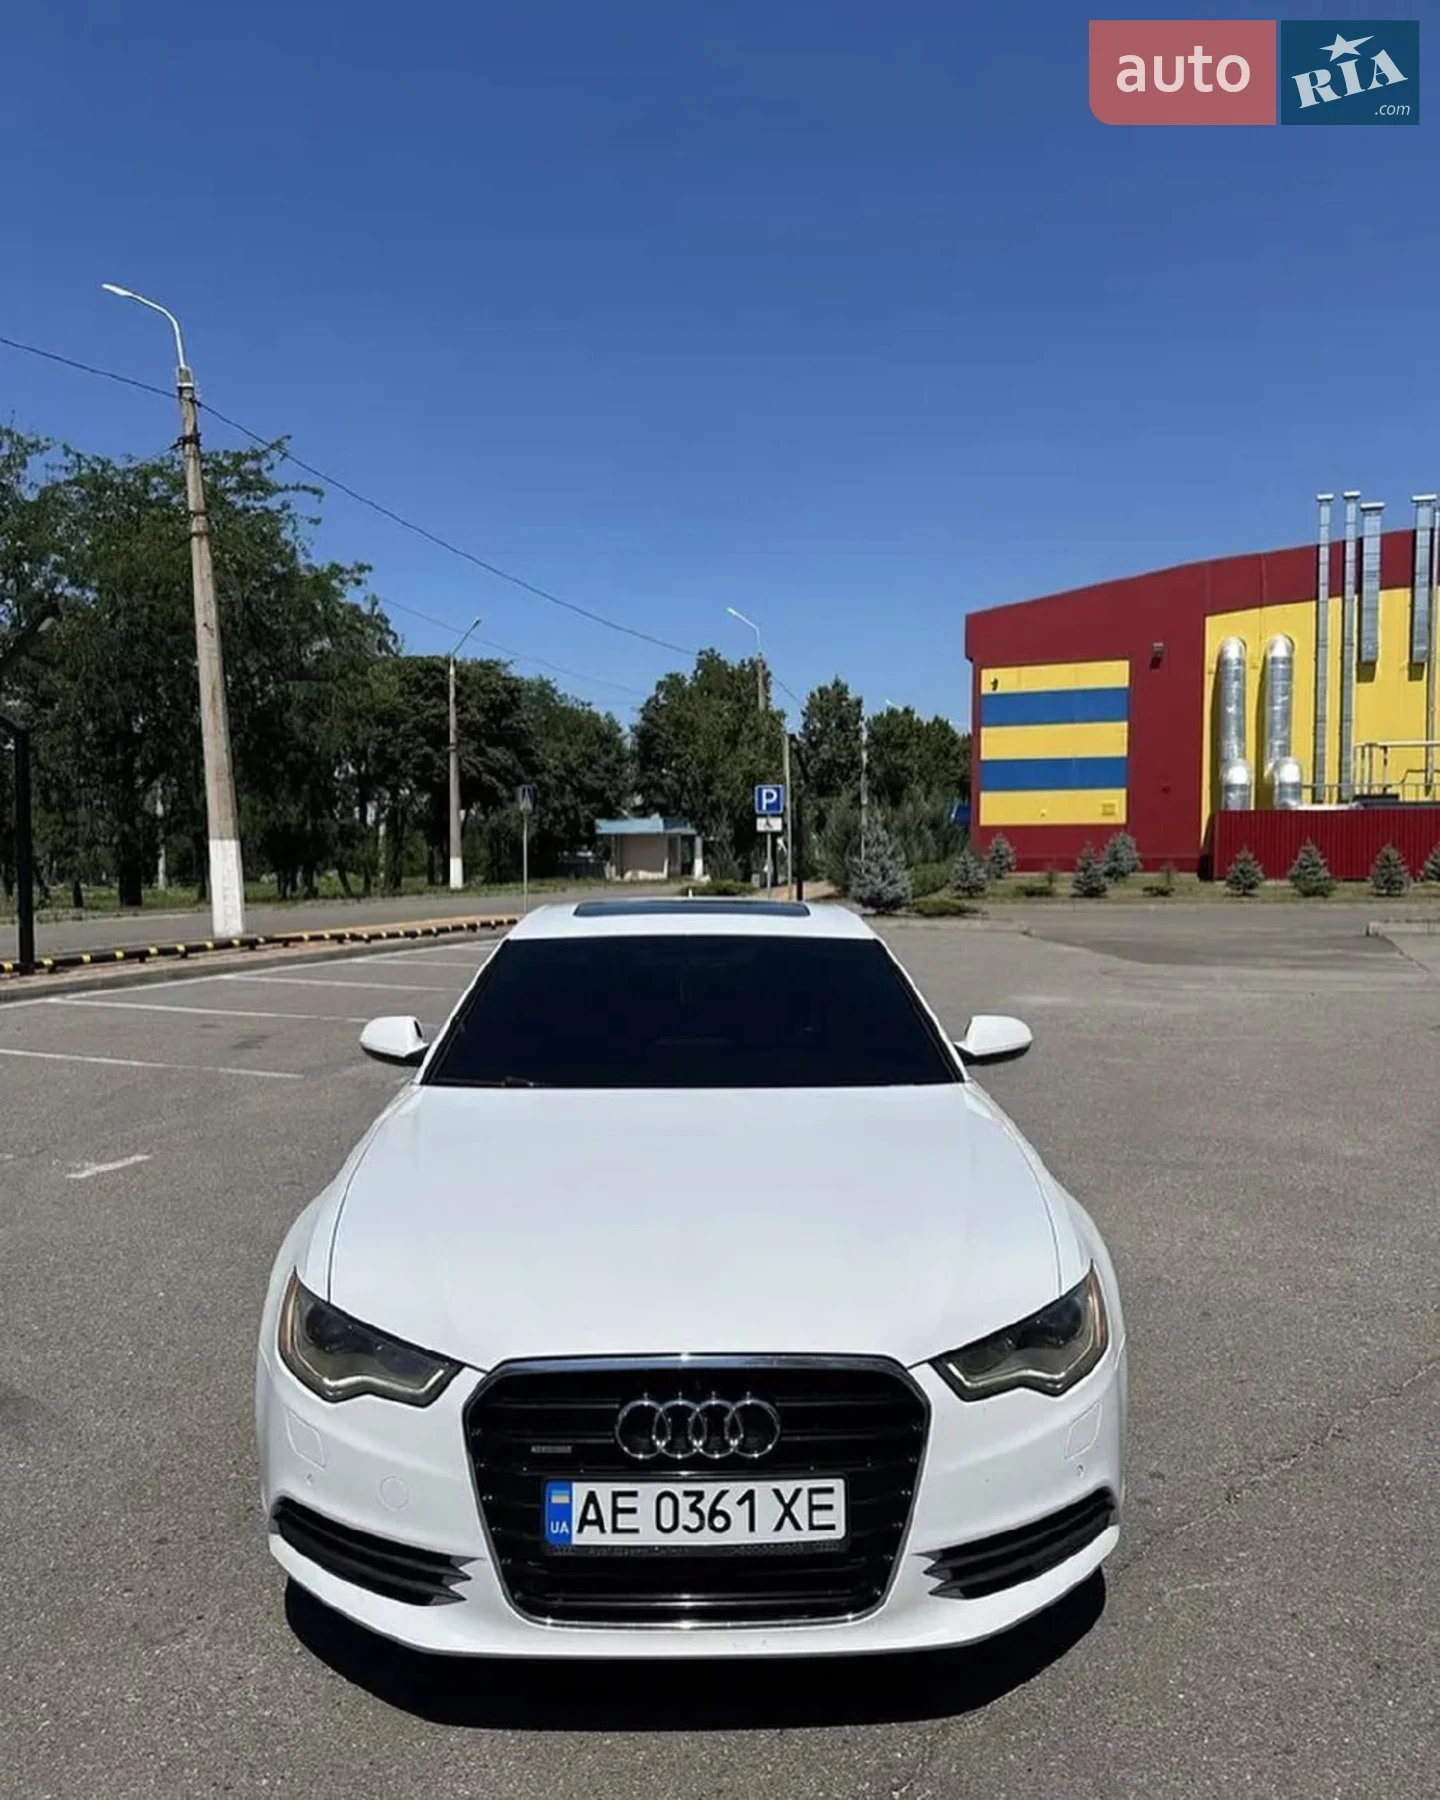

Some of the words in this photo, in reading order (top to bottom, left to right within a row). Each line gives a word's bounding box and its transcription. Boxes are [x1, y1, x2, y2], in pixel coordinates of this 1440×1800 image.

[762, 788, 777, 811] P
[577, 1490, 639, 1534] AE
[655, 1488, 756, 1533] 0361
[772, 1487, 836, 1532] XE
[550, 1520, 569, 1534] UA
